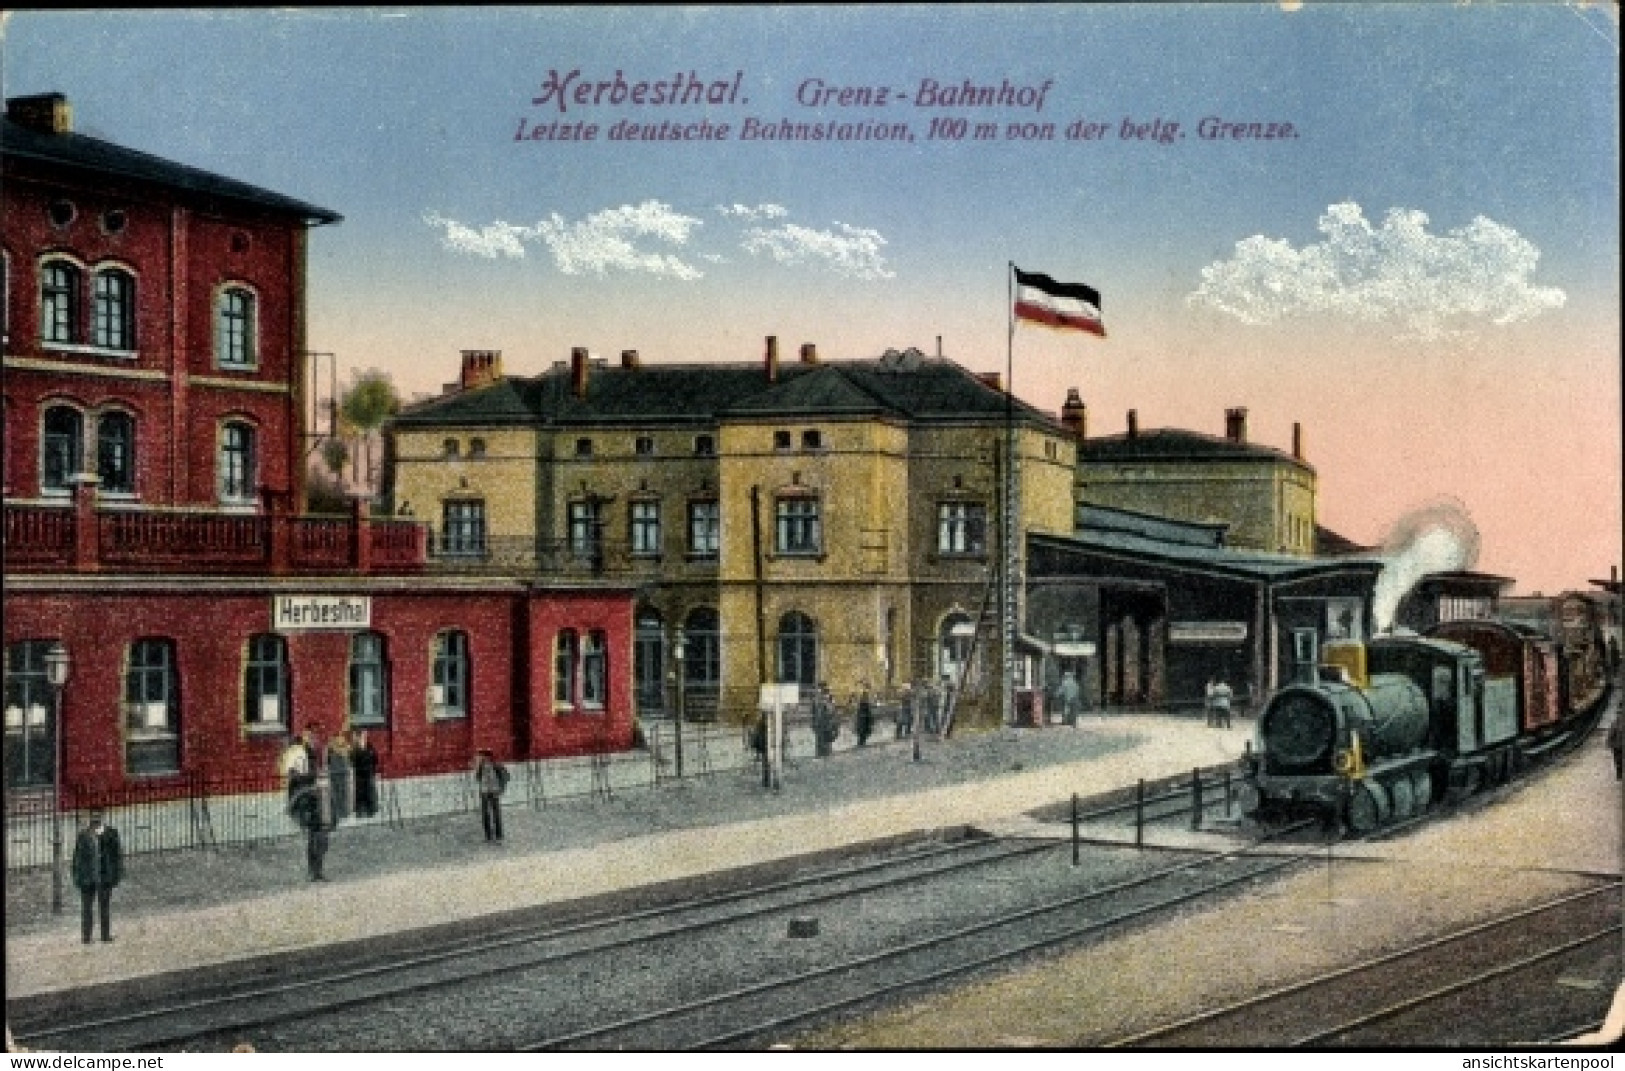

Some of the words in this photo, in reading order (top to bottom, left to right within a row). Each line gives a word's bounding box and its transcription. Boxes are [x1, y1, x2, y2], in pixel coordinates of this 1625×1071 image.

[532, 69, 749, 113] Herbesthal.
[513, 117, 600, 141] Letzte
[607, 117, 731, 141] deutsche
[740, 116, 914, 143] Bahnstation,
[927, 116, 968, 141] 100
[973, 122, 998, 141] m
[1005, 122, 1056, 141] von
[1064, 118, 1111, 141] der
[1197, 115, 1299, 141] Grenze.
[279, 598, 368, 623] Herbesthal
